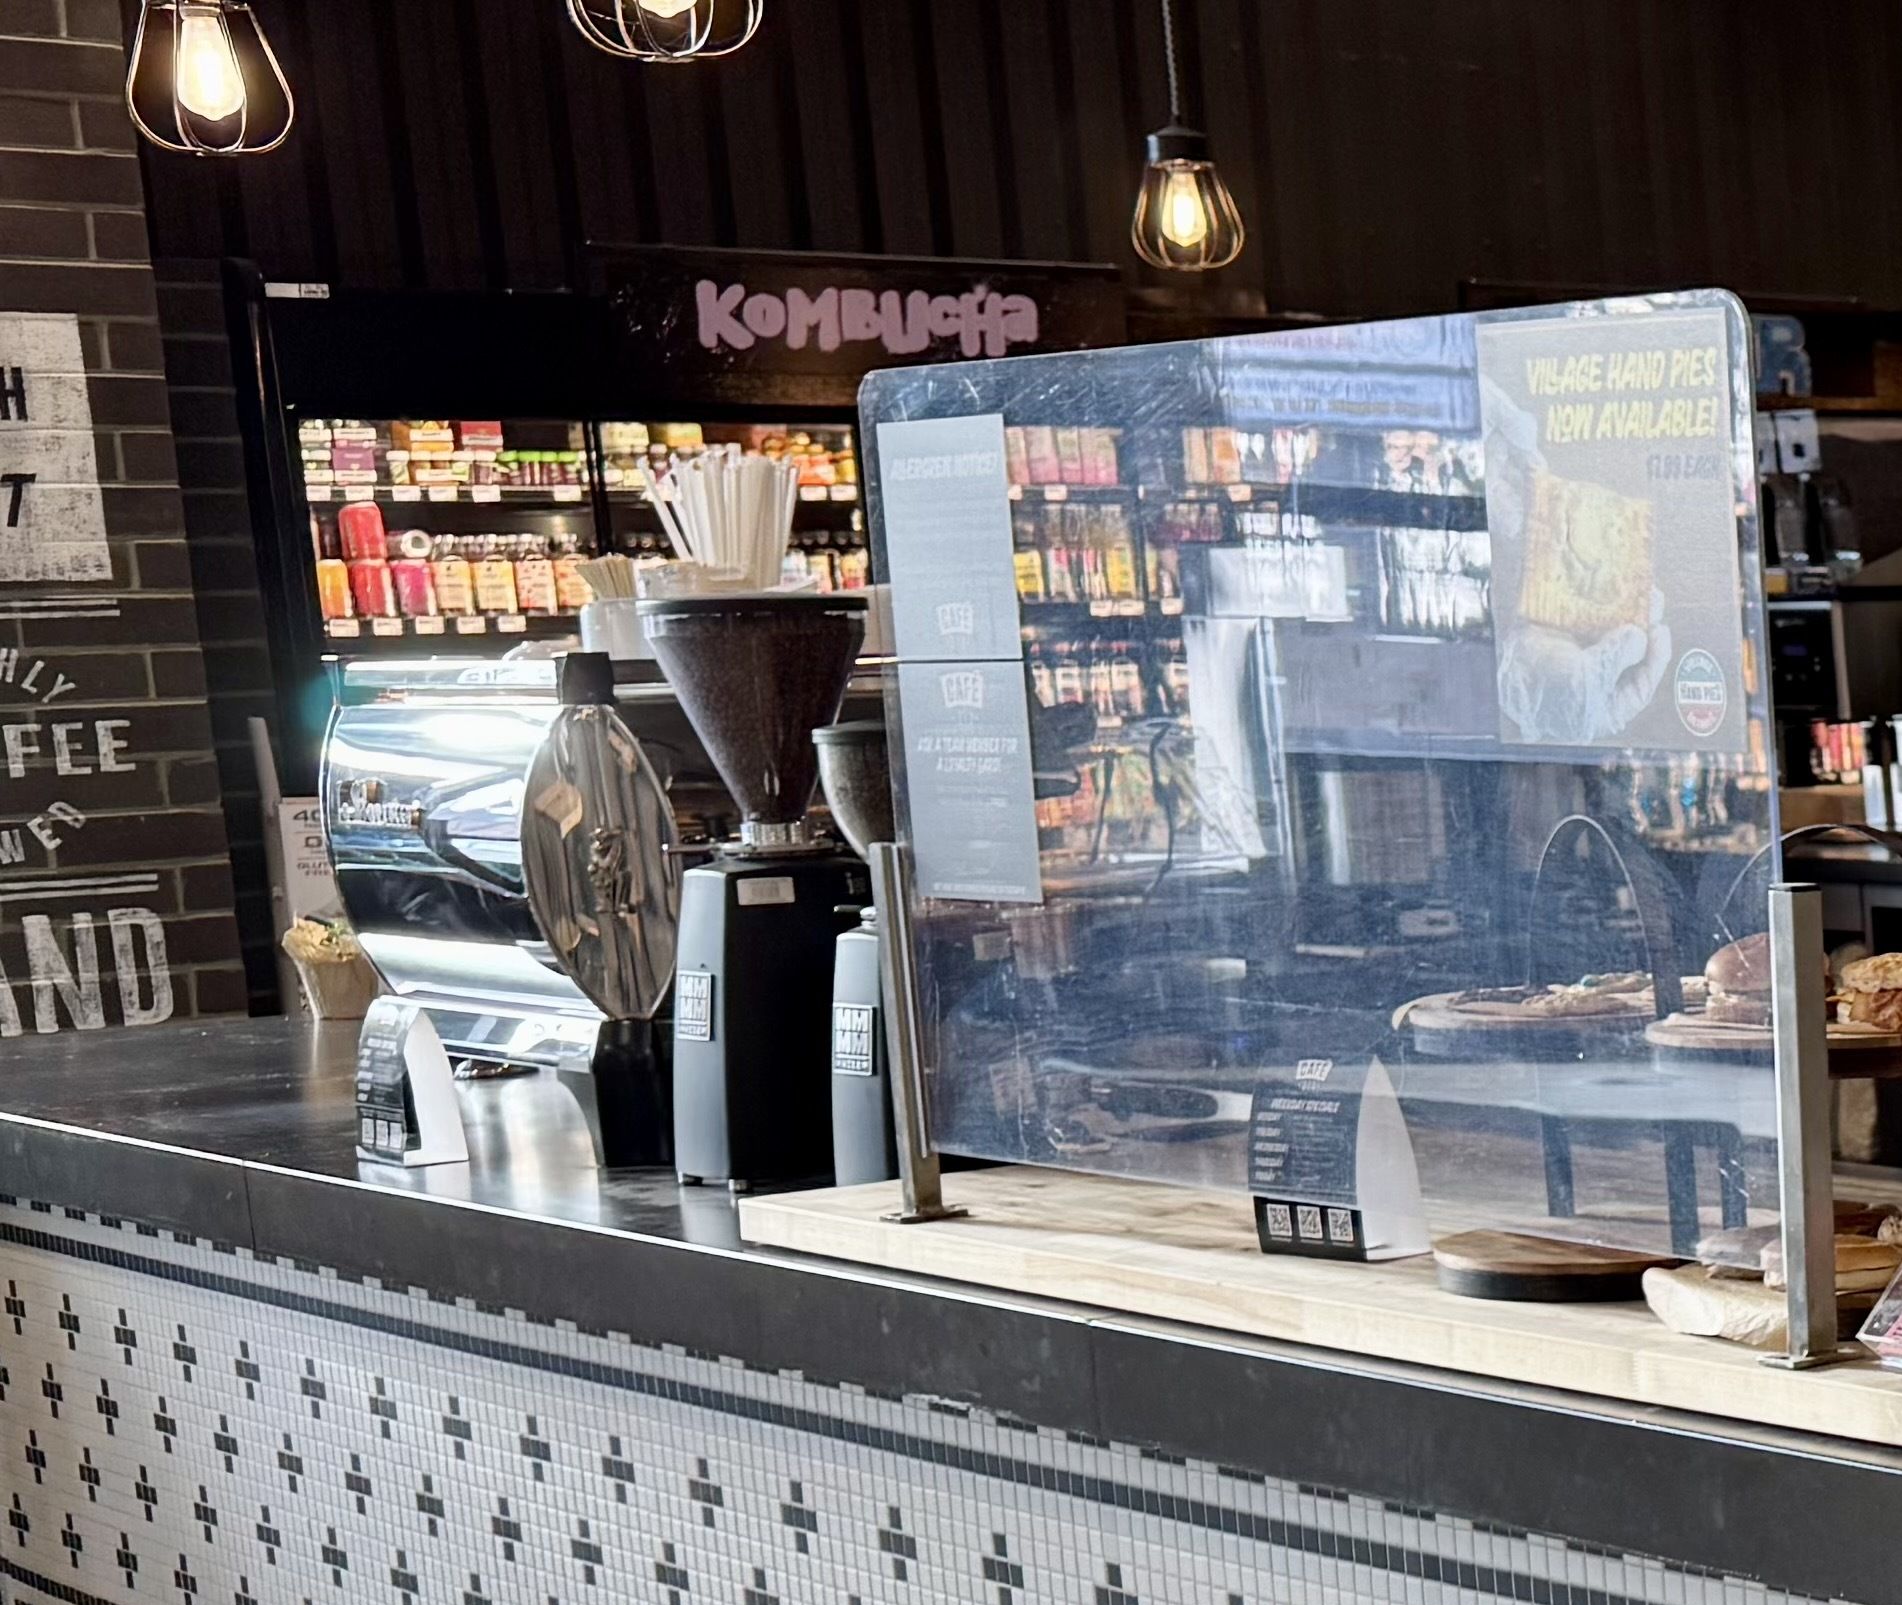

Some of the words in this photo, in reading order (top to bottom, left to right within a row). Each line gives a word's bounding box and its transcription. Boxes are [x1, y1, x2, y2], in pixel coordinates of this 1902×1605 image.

[1608, 351, 1667, 391] HAND
[1669, 346, 1717, 388] PIES
[1547, 401, 1592, 443] NOW
[1597, 396, 1719, 440] AVAILABLE!
